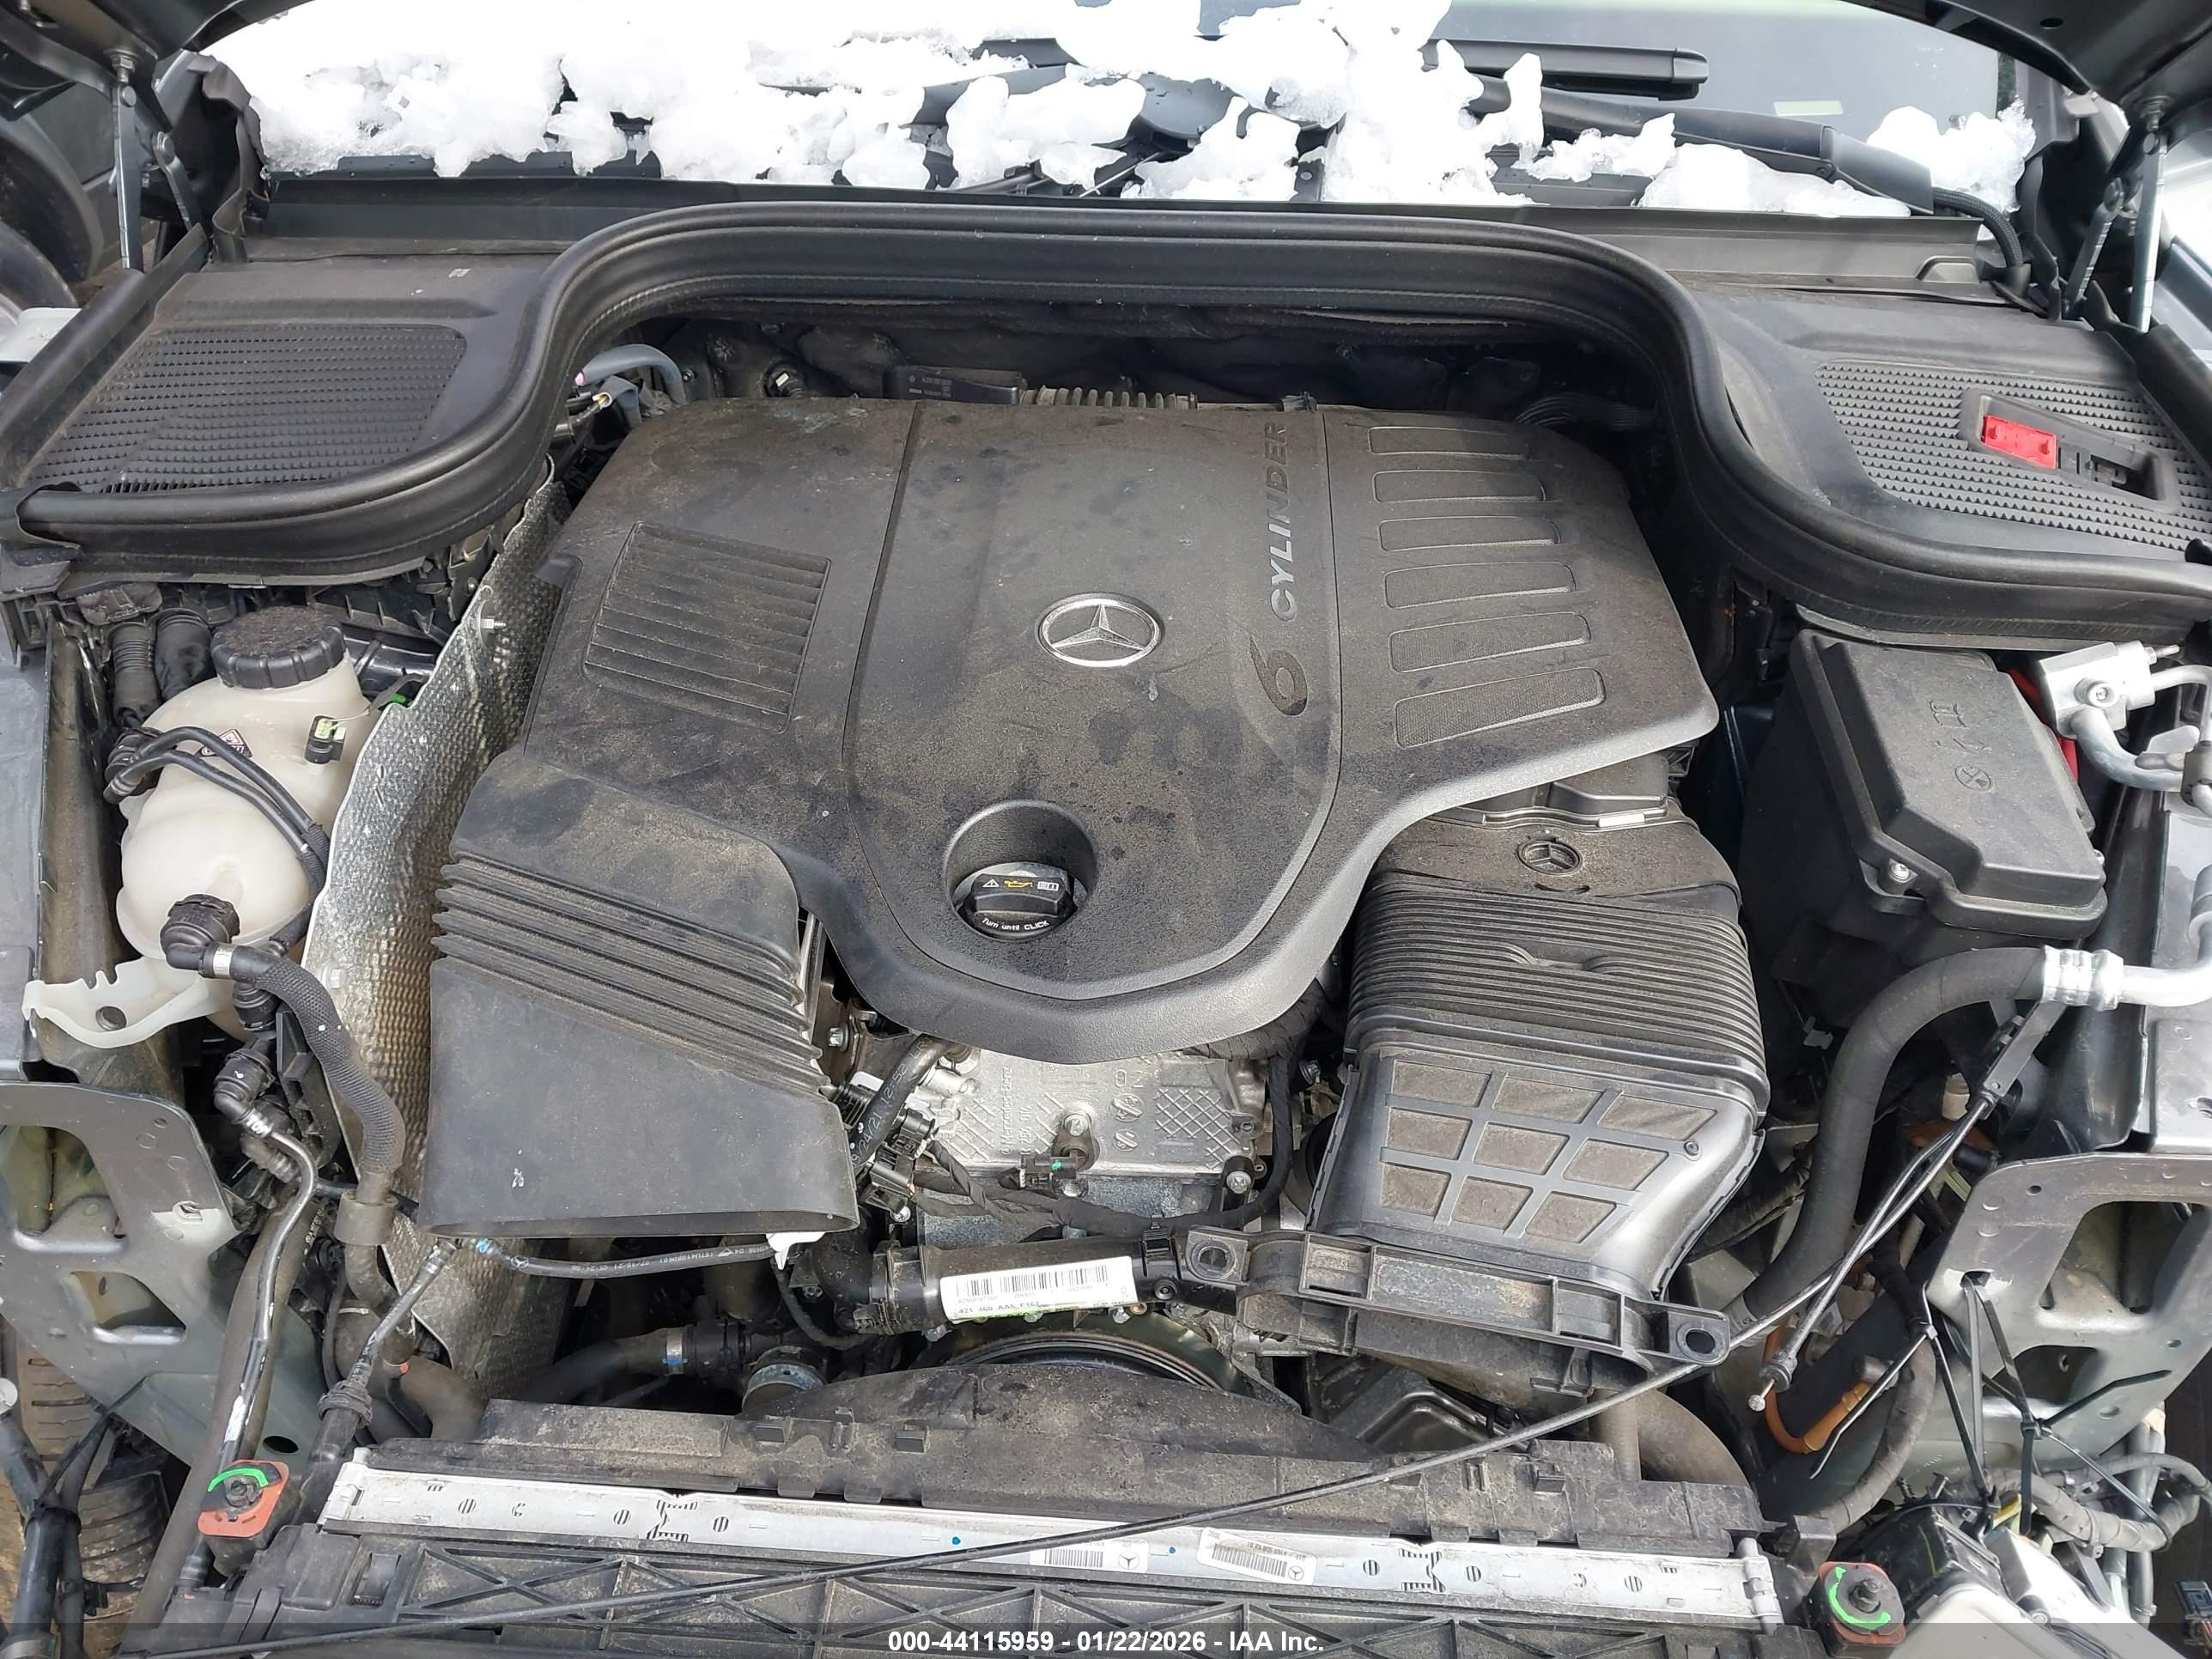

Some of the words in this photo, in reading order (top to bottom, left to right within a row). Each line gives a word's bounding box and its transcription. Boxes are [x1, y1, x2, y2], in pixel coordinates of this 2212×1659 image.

[1264, 421, 1297, 621] CYLINDER
[1250, 635, 1308, 716] 6
[981, 917, 999, 928] Turn
[1001, 923, 1020, 932] until
[1024, 920, 1050, 931] CLICK
[881, 1062, 909, 1106] 12:52
